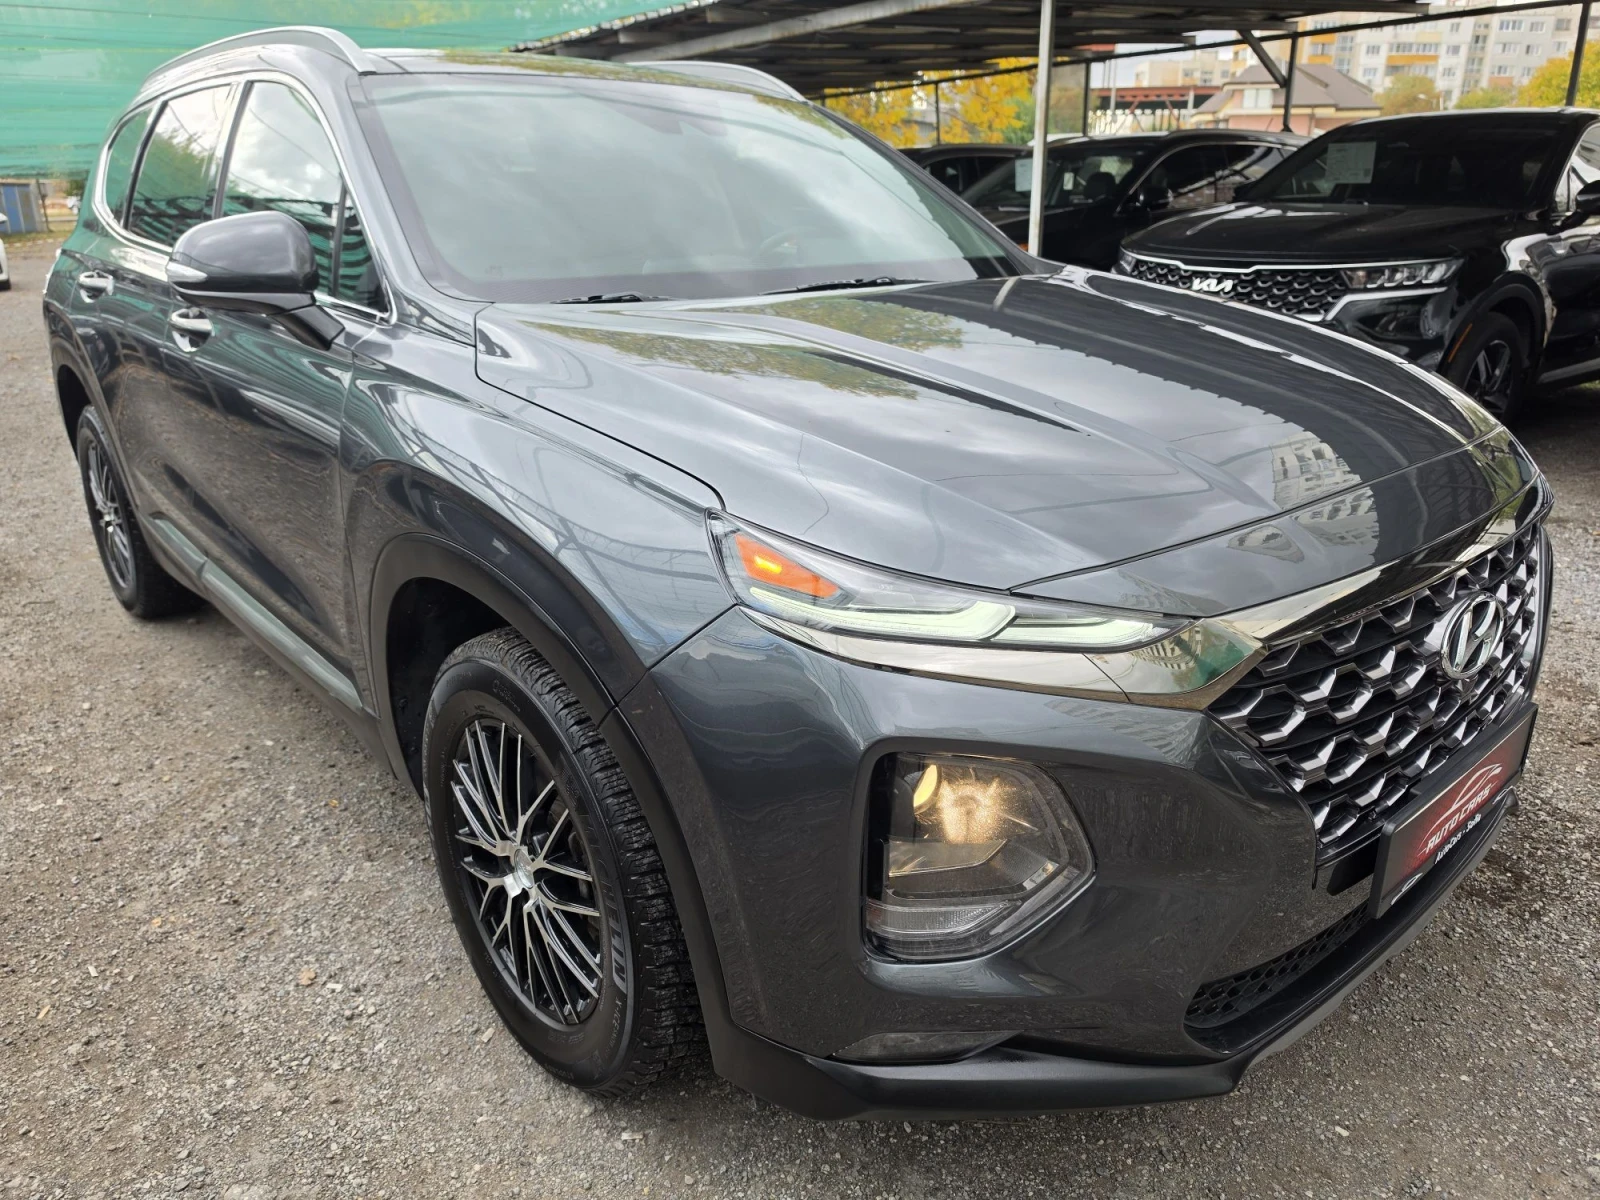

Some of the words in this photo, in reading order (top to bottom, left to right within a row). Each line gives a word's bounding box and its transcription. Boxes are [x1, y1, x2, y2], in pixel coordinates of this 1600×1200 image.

[1191, 277, 1234, 293] KIA
[1425, 812, 1461, 855] AUTO
[1459, 783, 1492, 821] CARS
